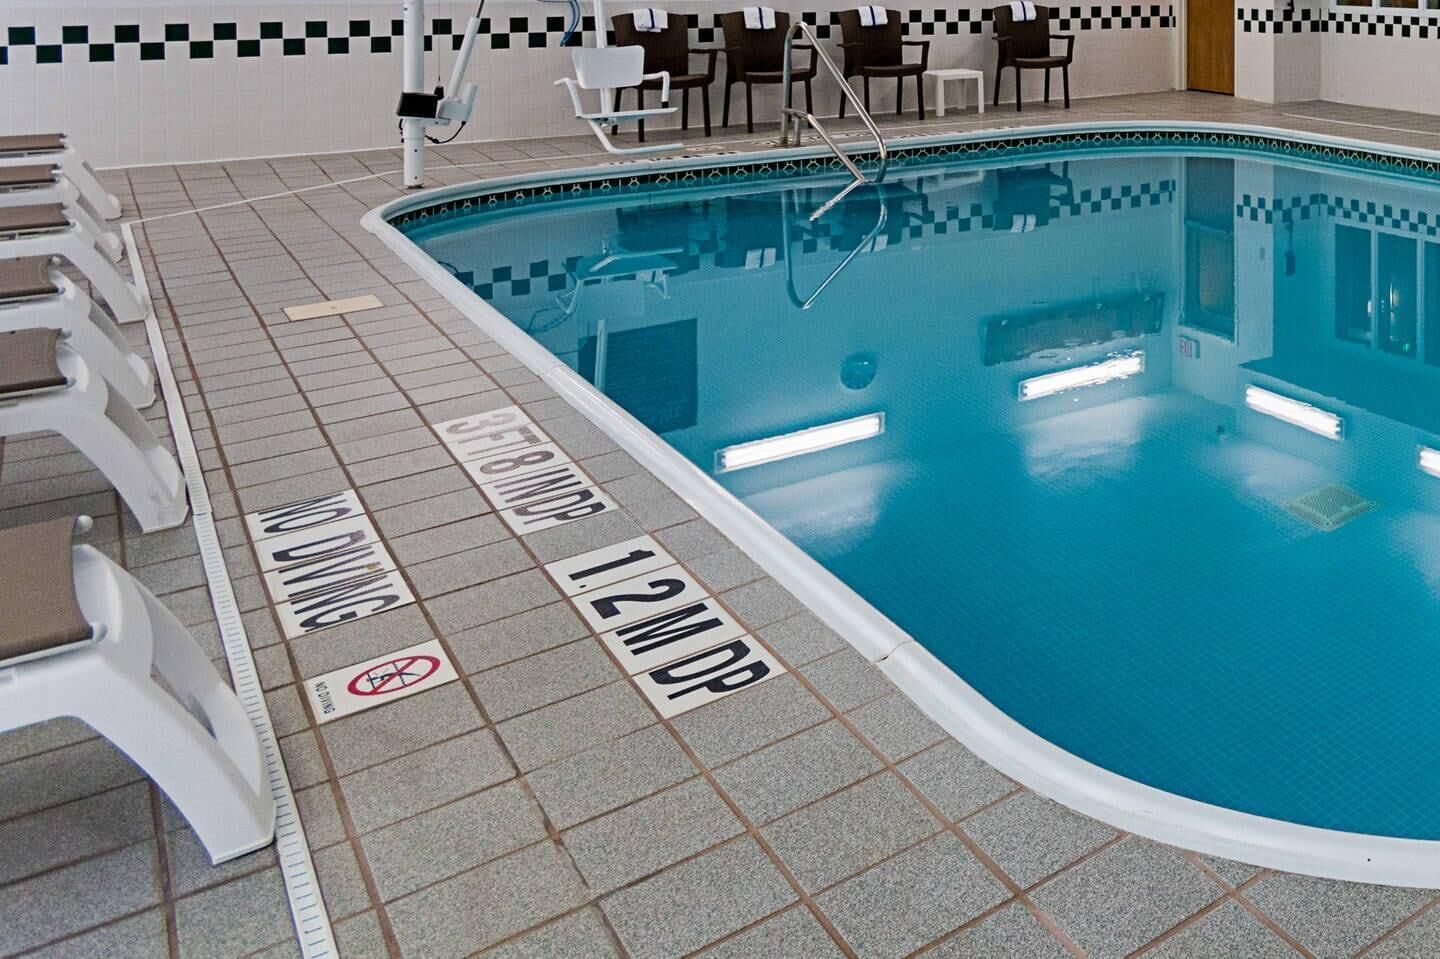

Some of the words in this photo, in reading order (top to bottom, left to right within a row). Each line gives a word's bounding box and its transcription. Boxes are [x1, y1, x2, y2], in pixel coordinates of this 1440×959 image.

[480, 451, 555, 475] 8
[258, 492, 352, 534] NO
[272, 530, 400, 633] DIVING
[318, 691, 336, 714] DIVING
